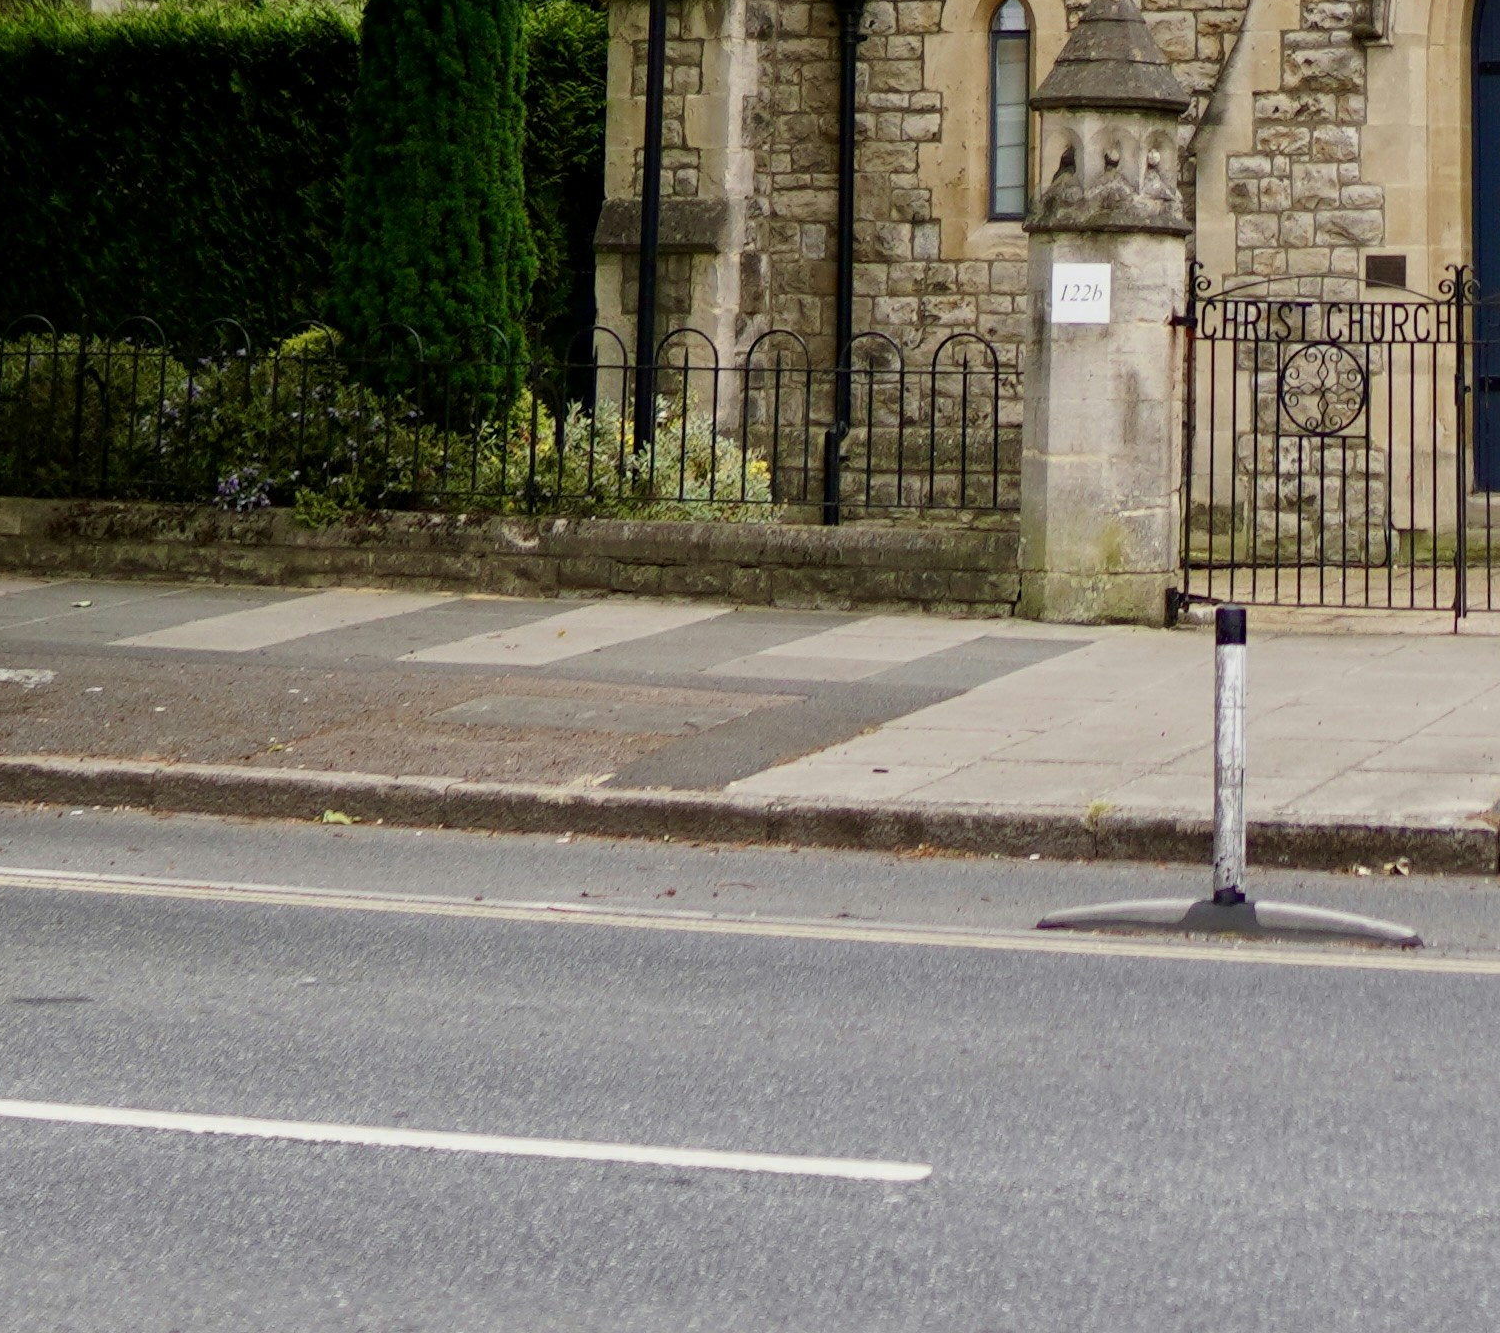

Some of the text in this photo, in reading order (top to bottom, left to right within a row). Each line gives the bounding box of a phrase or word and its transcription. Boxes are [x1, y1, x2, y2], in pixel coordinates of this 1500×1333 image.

[1061, 284, 1102, 301] 122b
[1201, 301, 1312, 340] CHRIST
[1326, 302, 1450, 342] CHURCH
